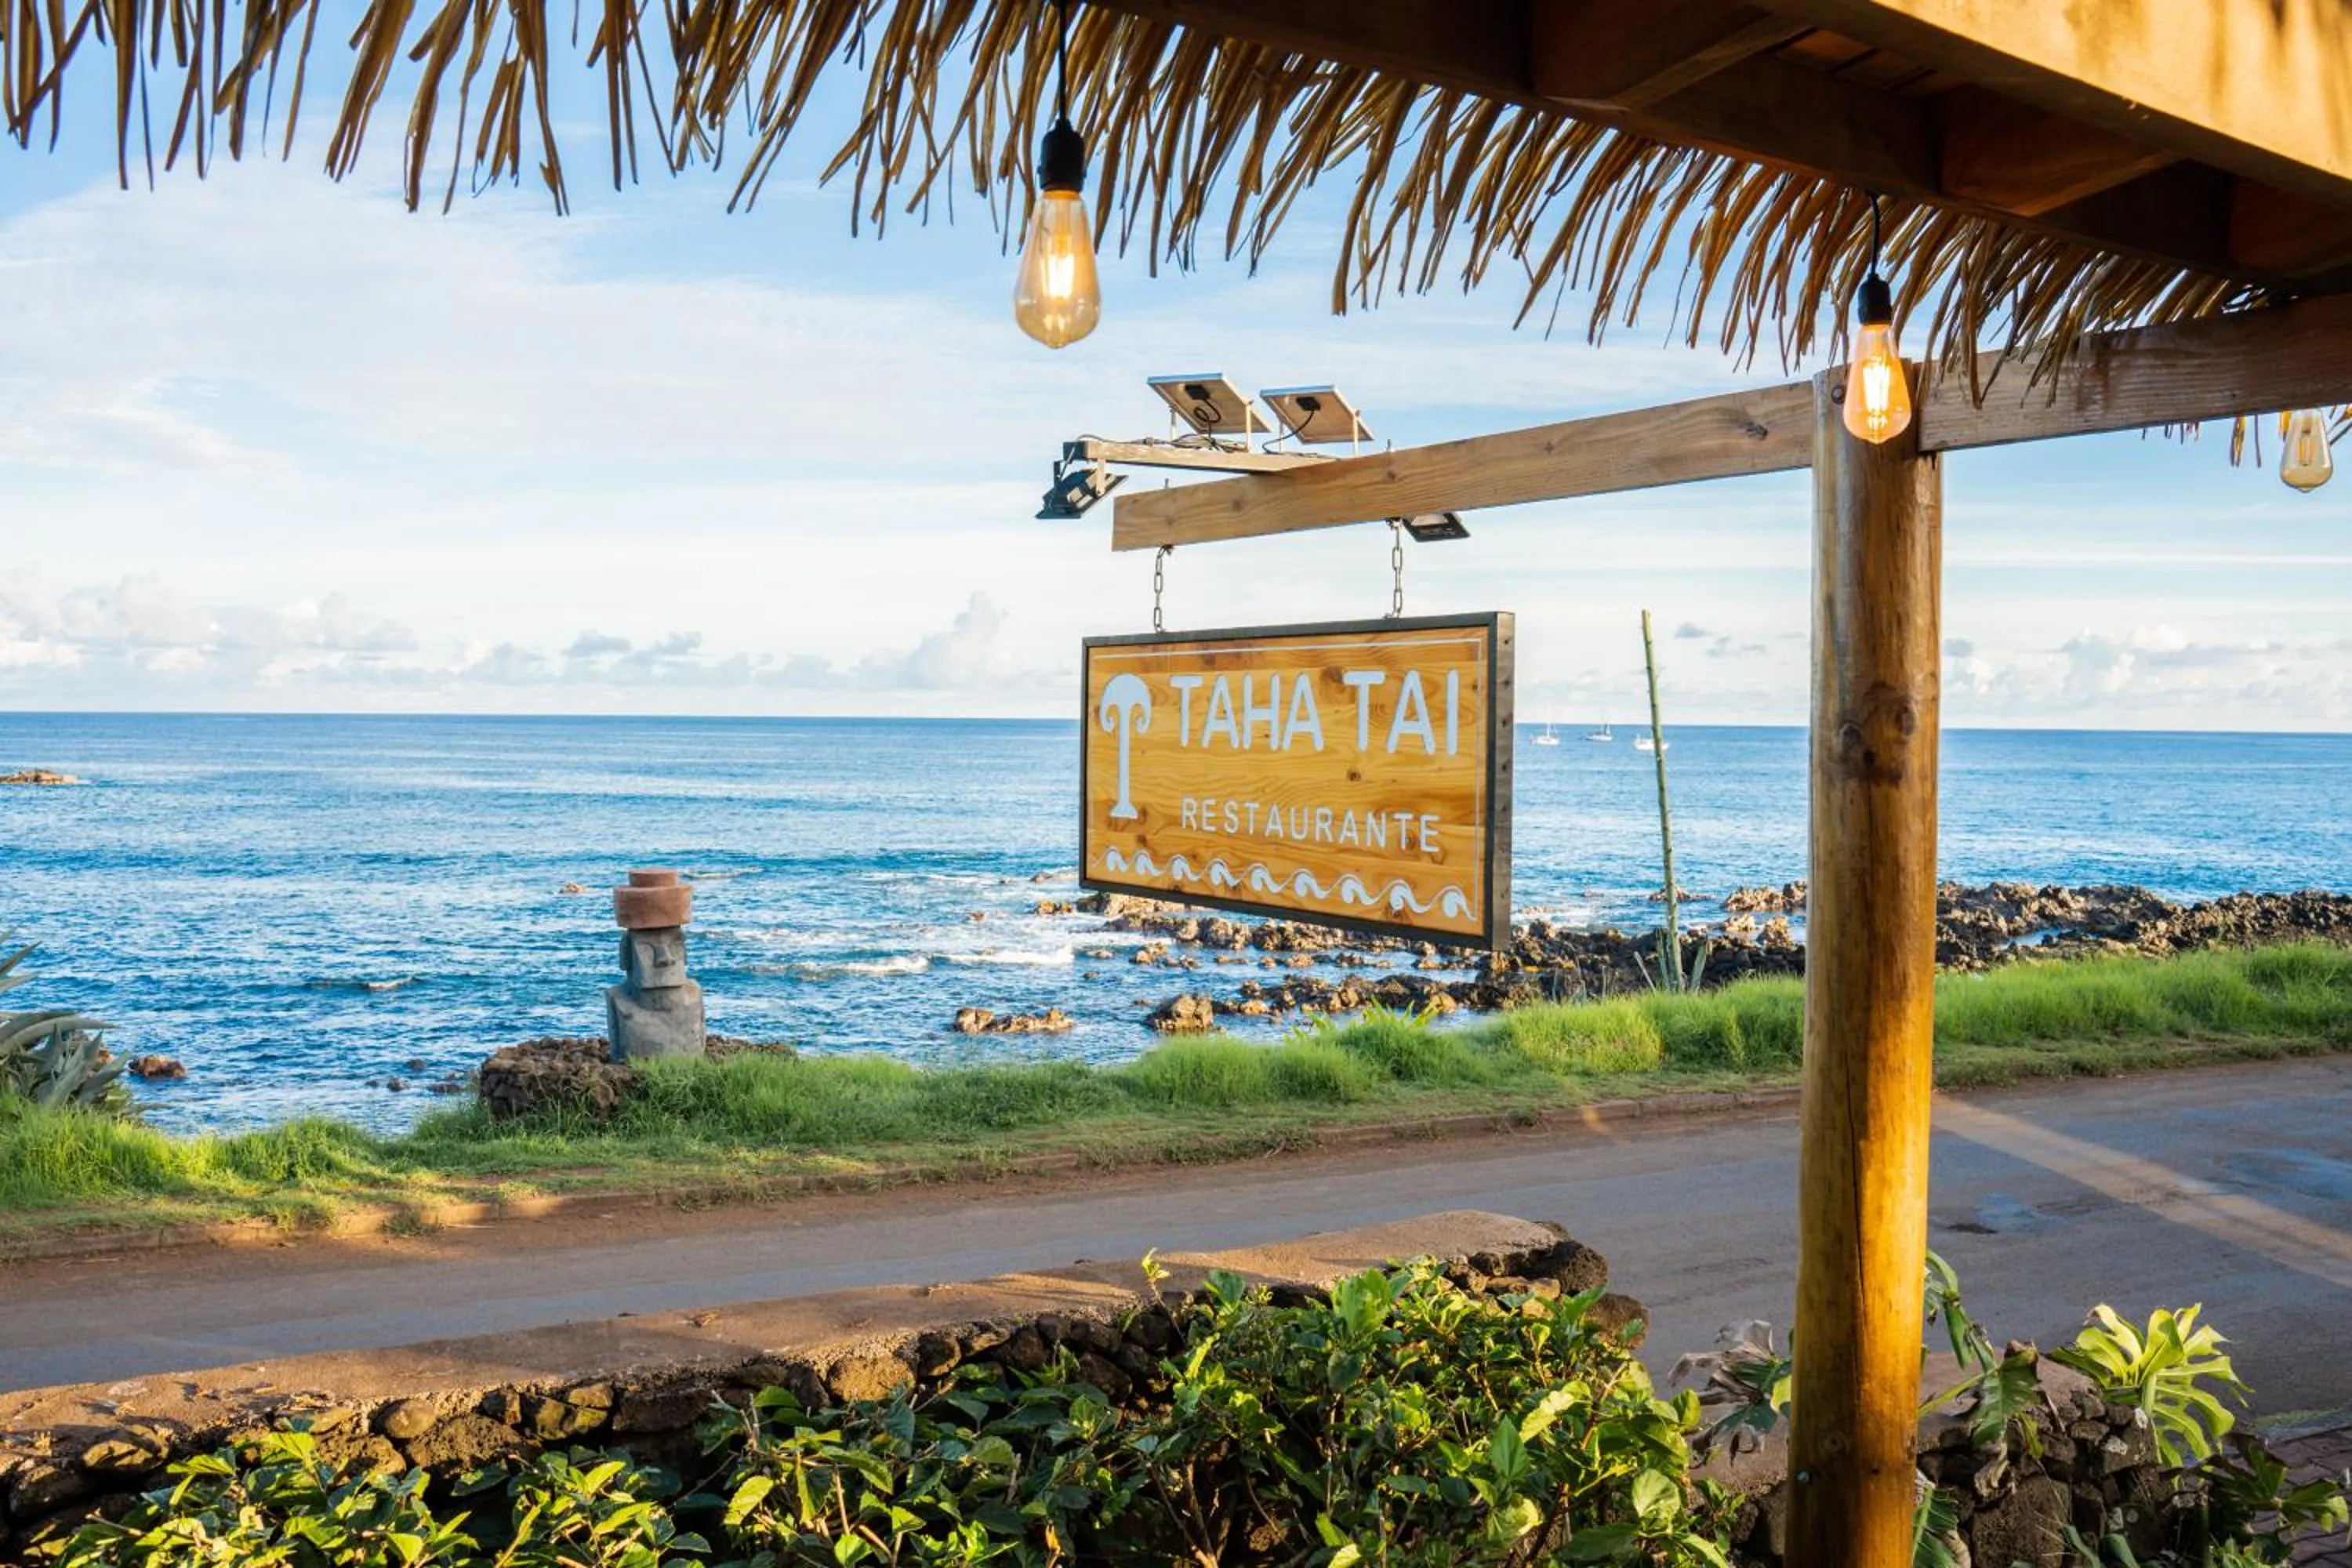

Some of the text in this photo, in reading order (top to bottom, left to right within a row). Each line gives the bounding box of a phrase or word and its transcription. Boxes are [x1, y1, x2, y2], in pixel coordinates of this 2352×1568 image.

[1170, 670, 1459, 756] TAHA TAI
[1181, 797, 1441, 853] RESTAURANTE
